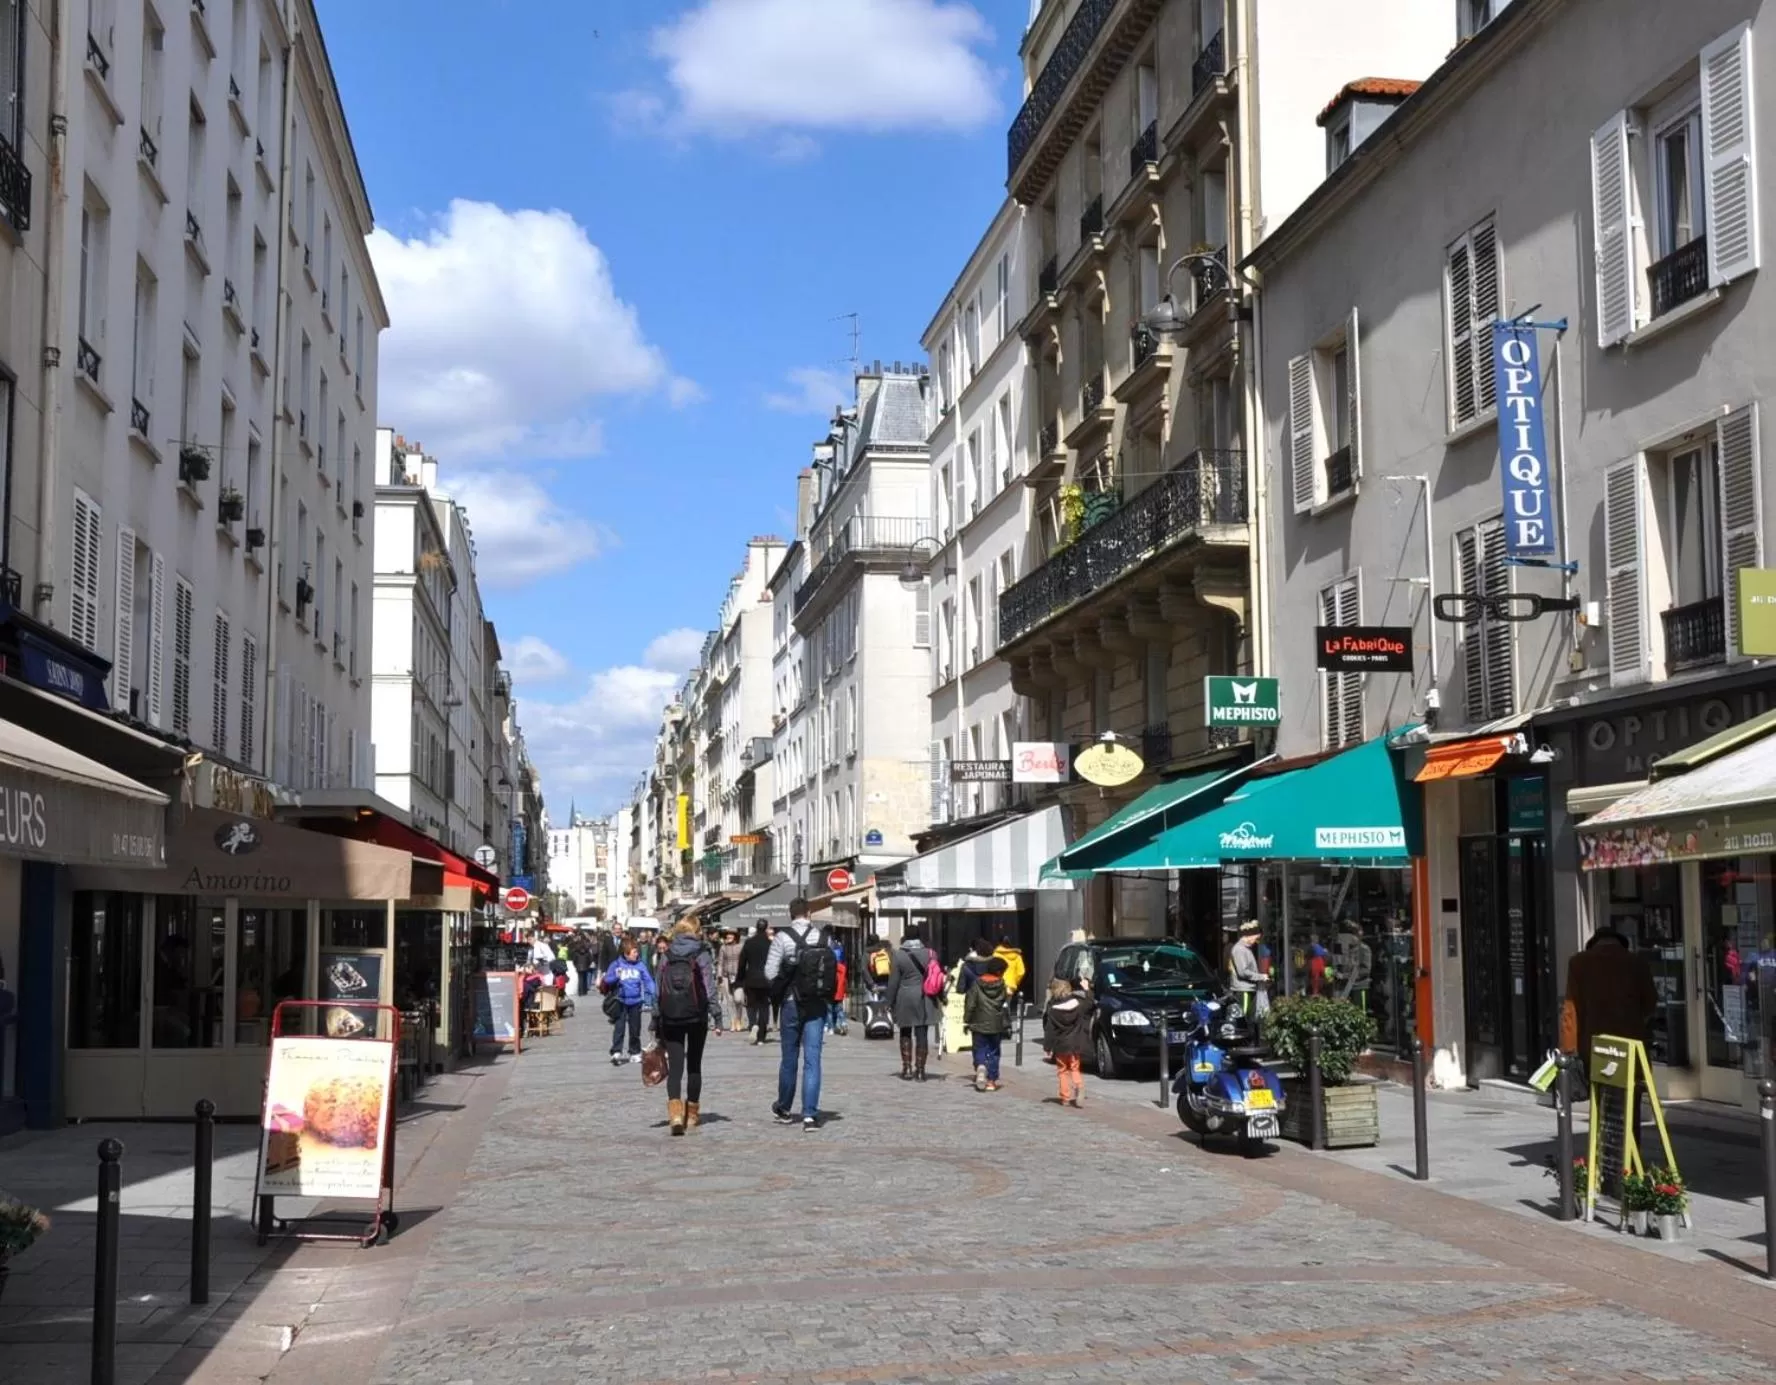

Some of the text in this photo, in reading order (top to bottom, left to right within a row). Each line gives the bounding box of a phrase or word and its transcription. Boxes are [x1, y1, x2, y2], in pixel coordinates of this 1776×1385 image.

[1501, 339, 1544, 546] OPTIQUE
[1212, 706, 1277, 721] MEPHISTO
[1319, 831, 1385, 845] MEPHISTO
[1743, 832, 1774, 848] nom
[180, 865, 291, 891] Amorino
